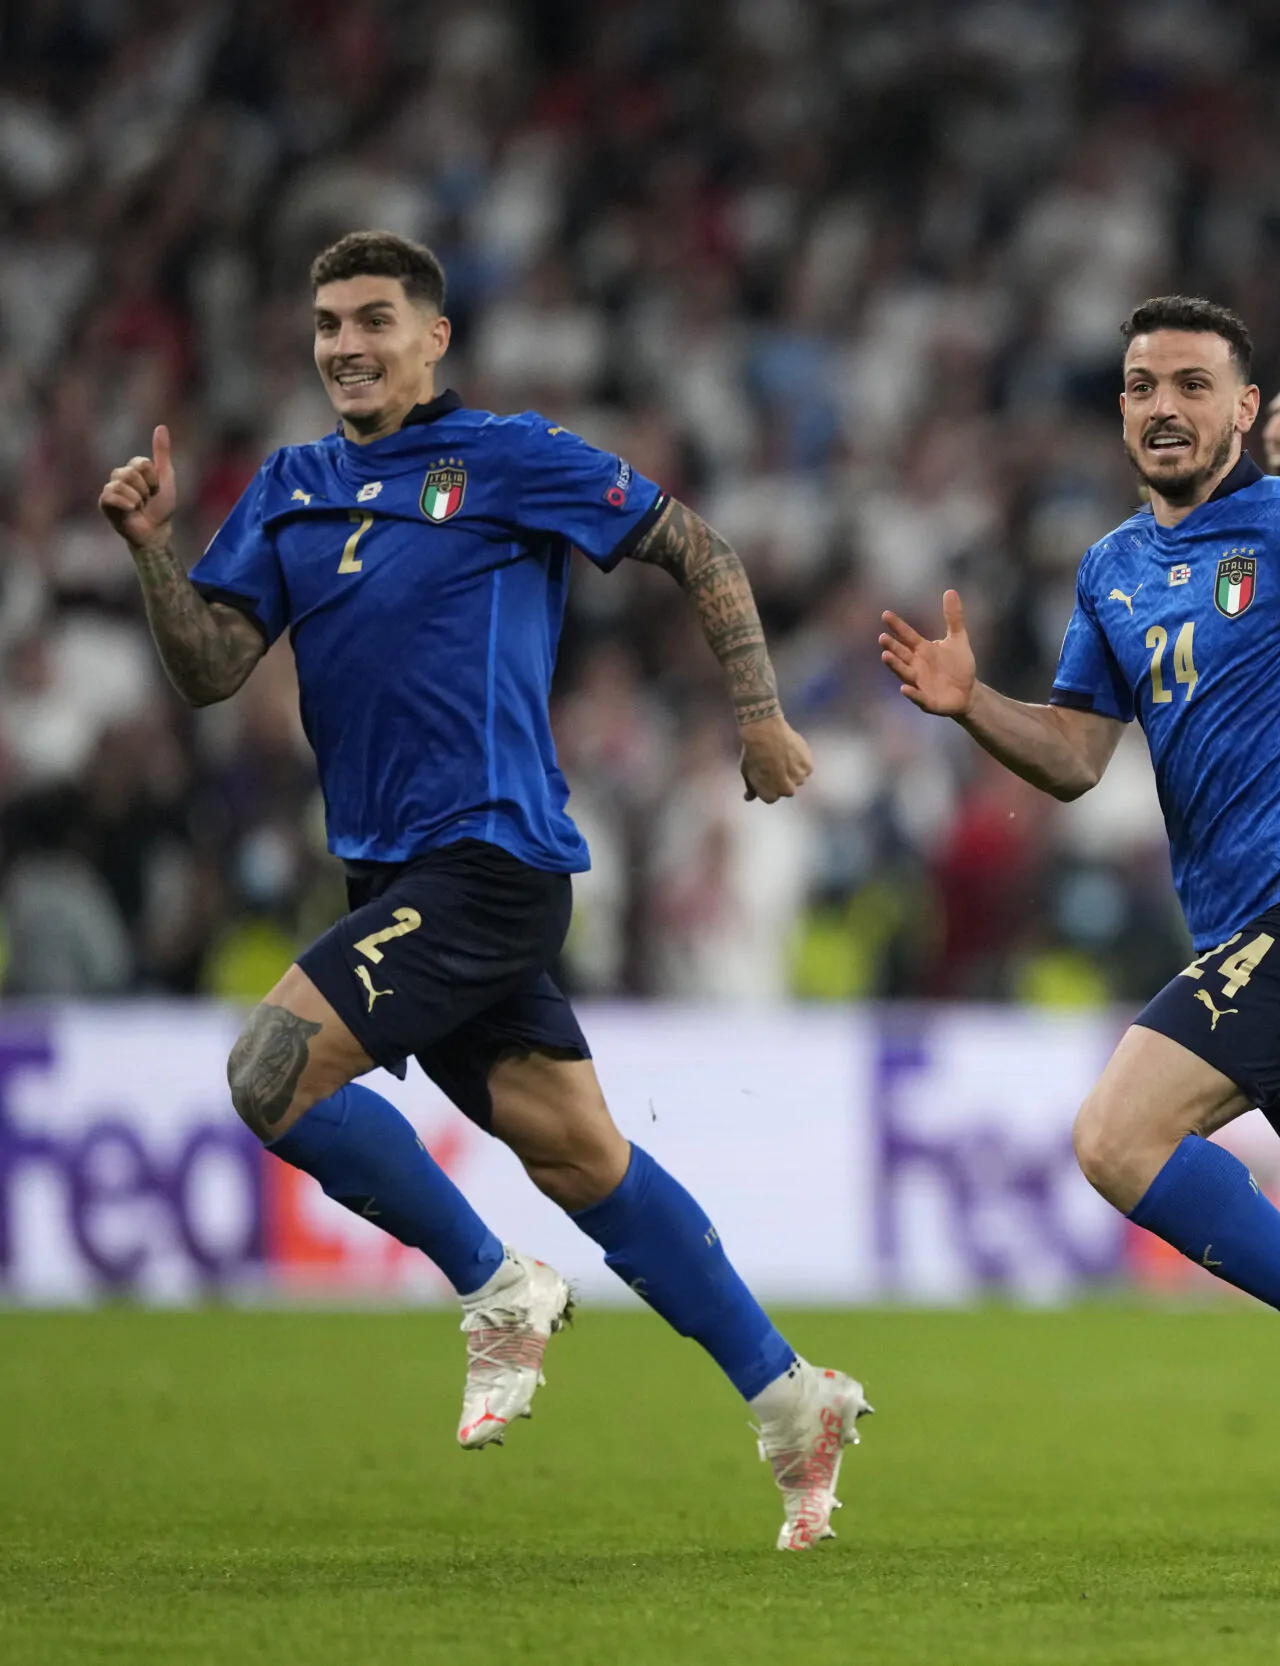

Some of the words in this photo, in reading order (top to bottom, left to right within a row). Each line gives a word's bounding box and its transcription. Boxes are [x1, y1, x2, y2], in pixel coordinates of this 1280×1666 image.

[429, 472, 464, 483] ITALIA
[337, 509, 374, 575] 2
[1220, 561, 1253, 572] ITALIA
[1145, 621, 1199, 704] 24
[352, 906, 422, 965] 2
